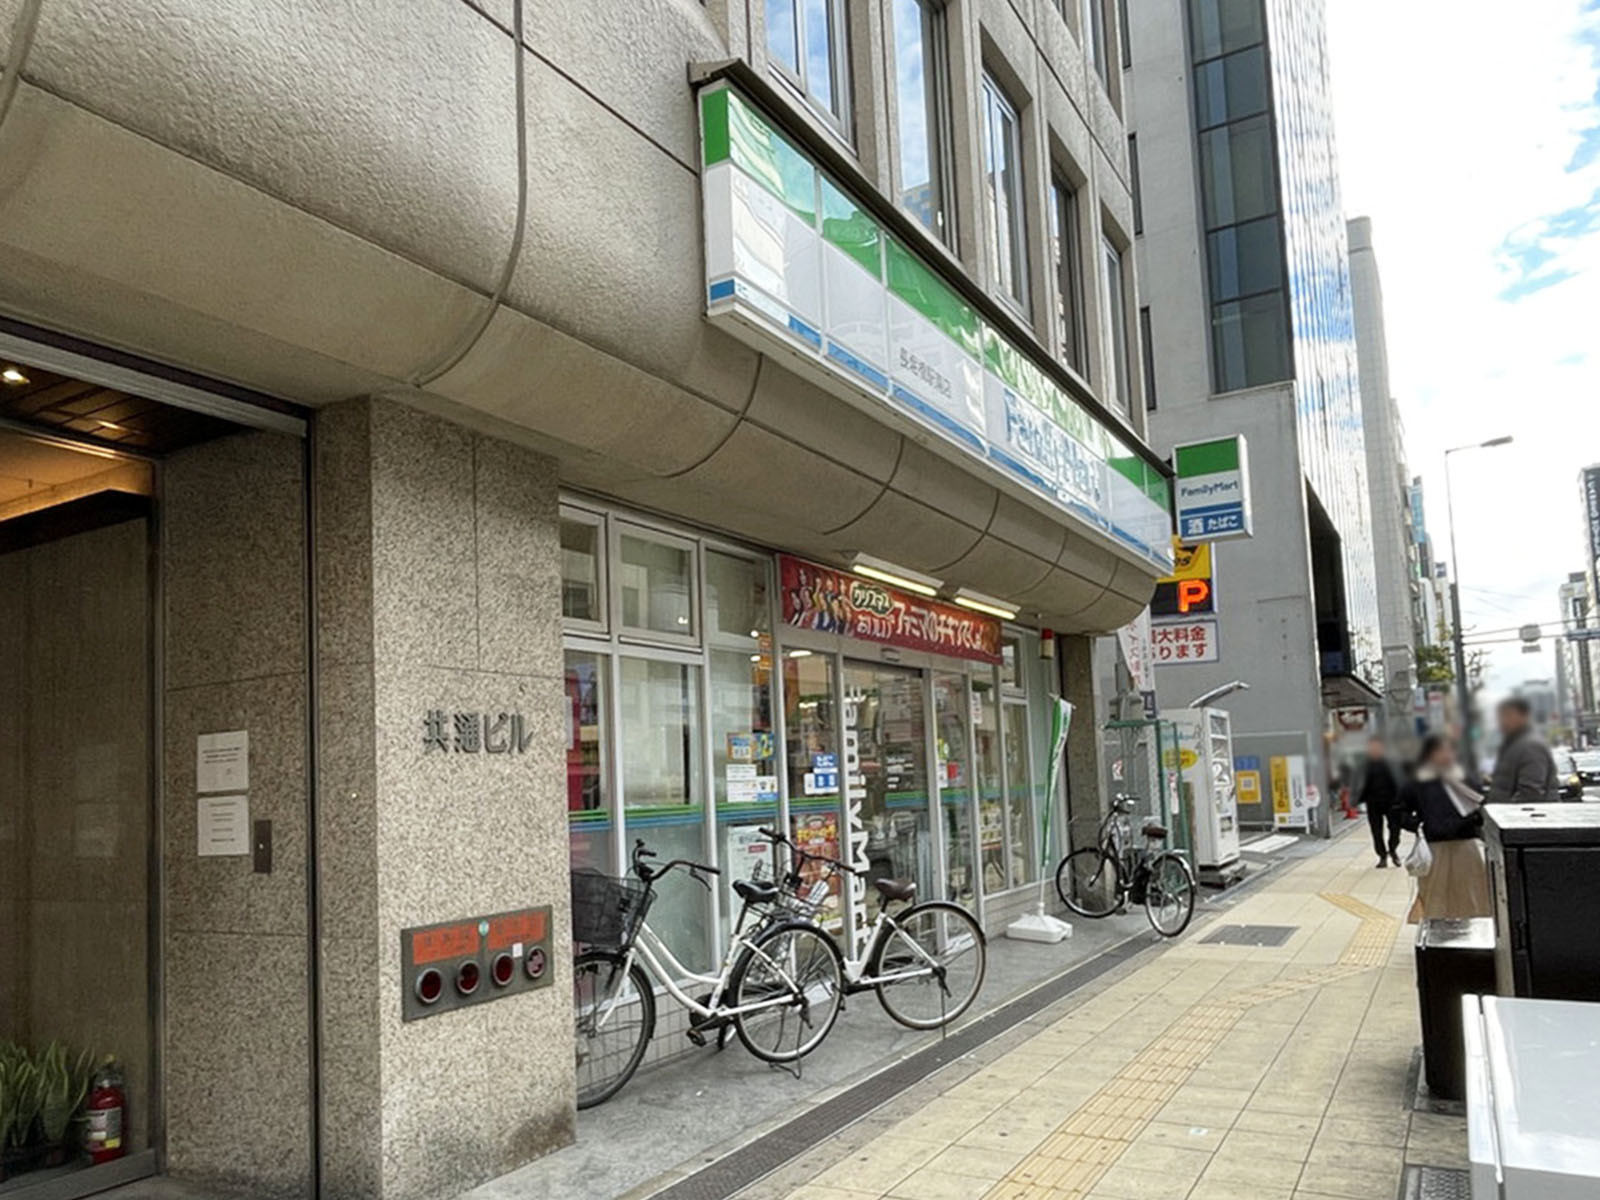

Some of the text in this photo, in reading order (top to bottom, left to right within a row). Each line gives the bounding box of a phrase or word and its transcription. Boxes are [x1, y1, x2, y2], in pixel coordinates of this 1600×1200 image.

[1181, 481, 1238, 496] FamilyMart
[1208, 515, 1239, 530] たばこ
[1178, 579, 1209, 613] P
[423, 709, 535, 754] 共通ビル
